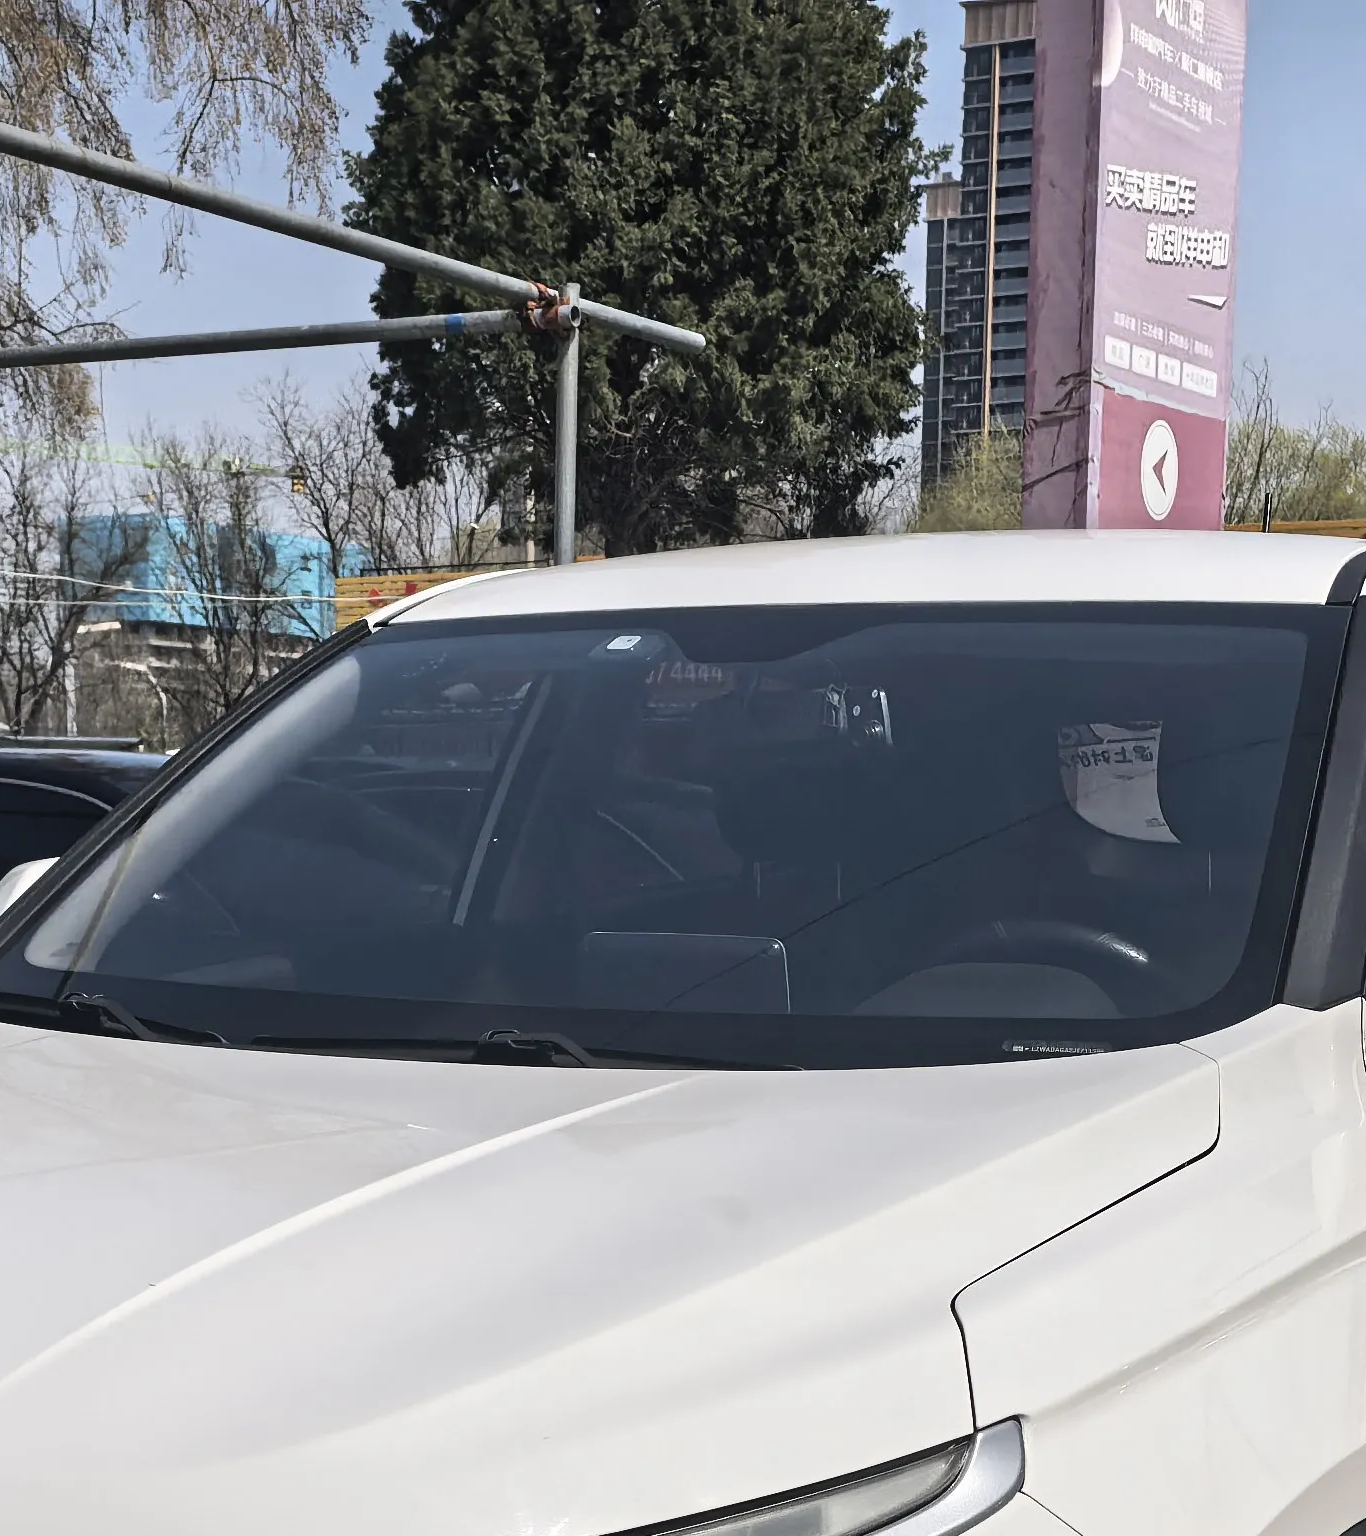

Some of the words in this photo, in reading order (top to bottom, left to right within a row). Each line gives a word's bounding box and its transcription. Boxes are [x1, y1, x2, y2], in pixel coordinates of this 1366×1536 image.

[1105, 164, 1197, 217] 买卖精品车
